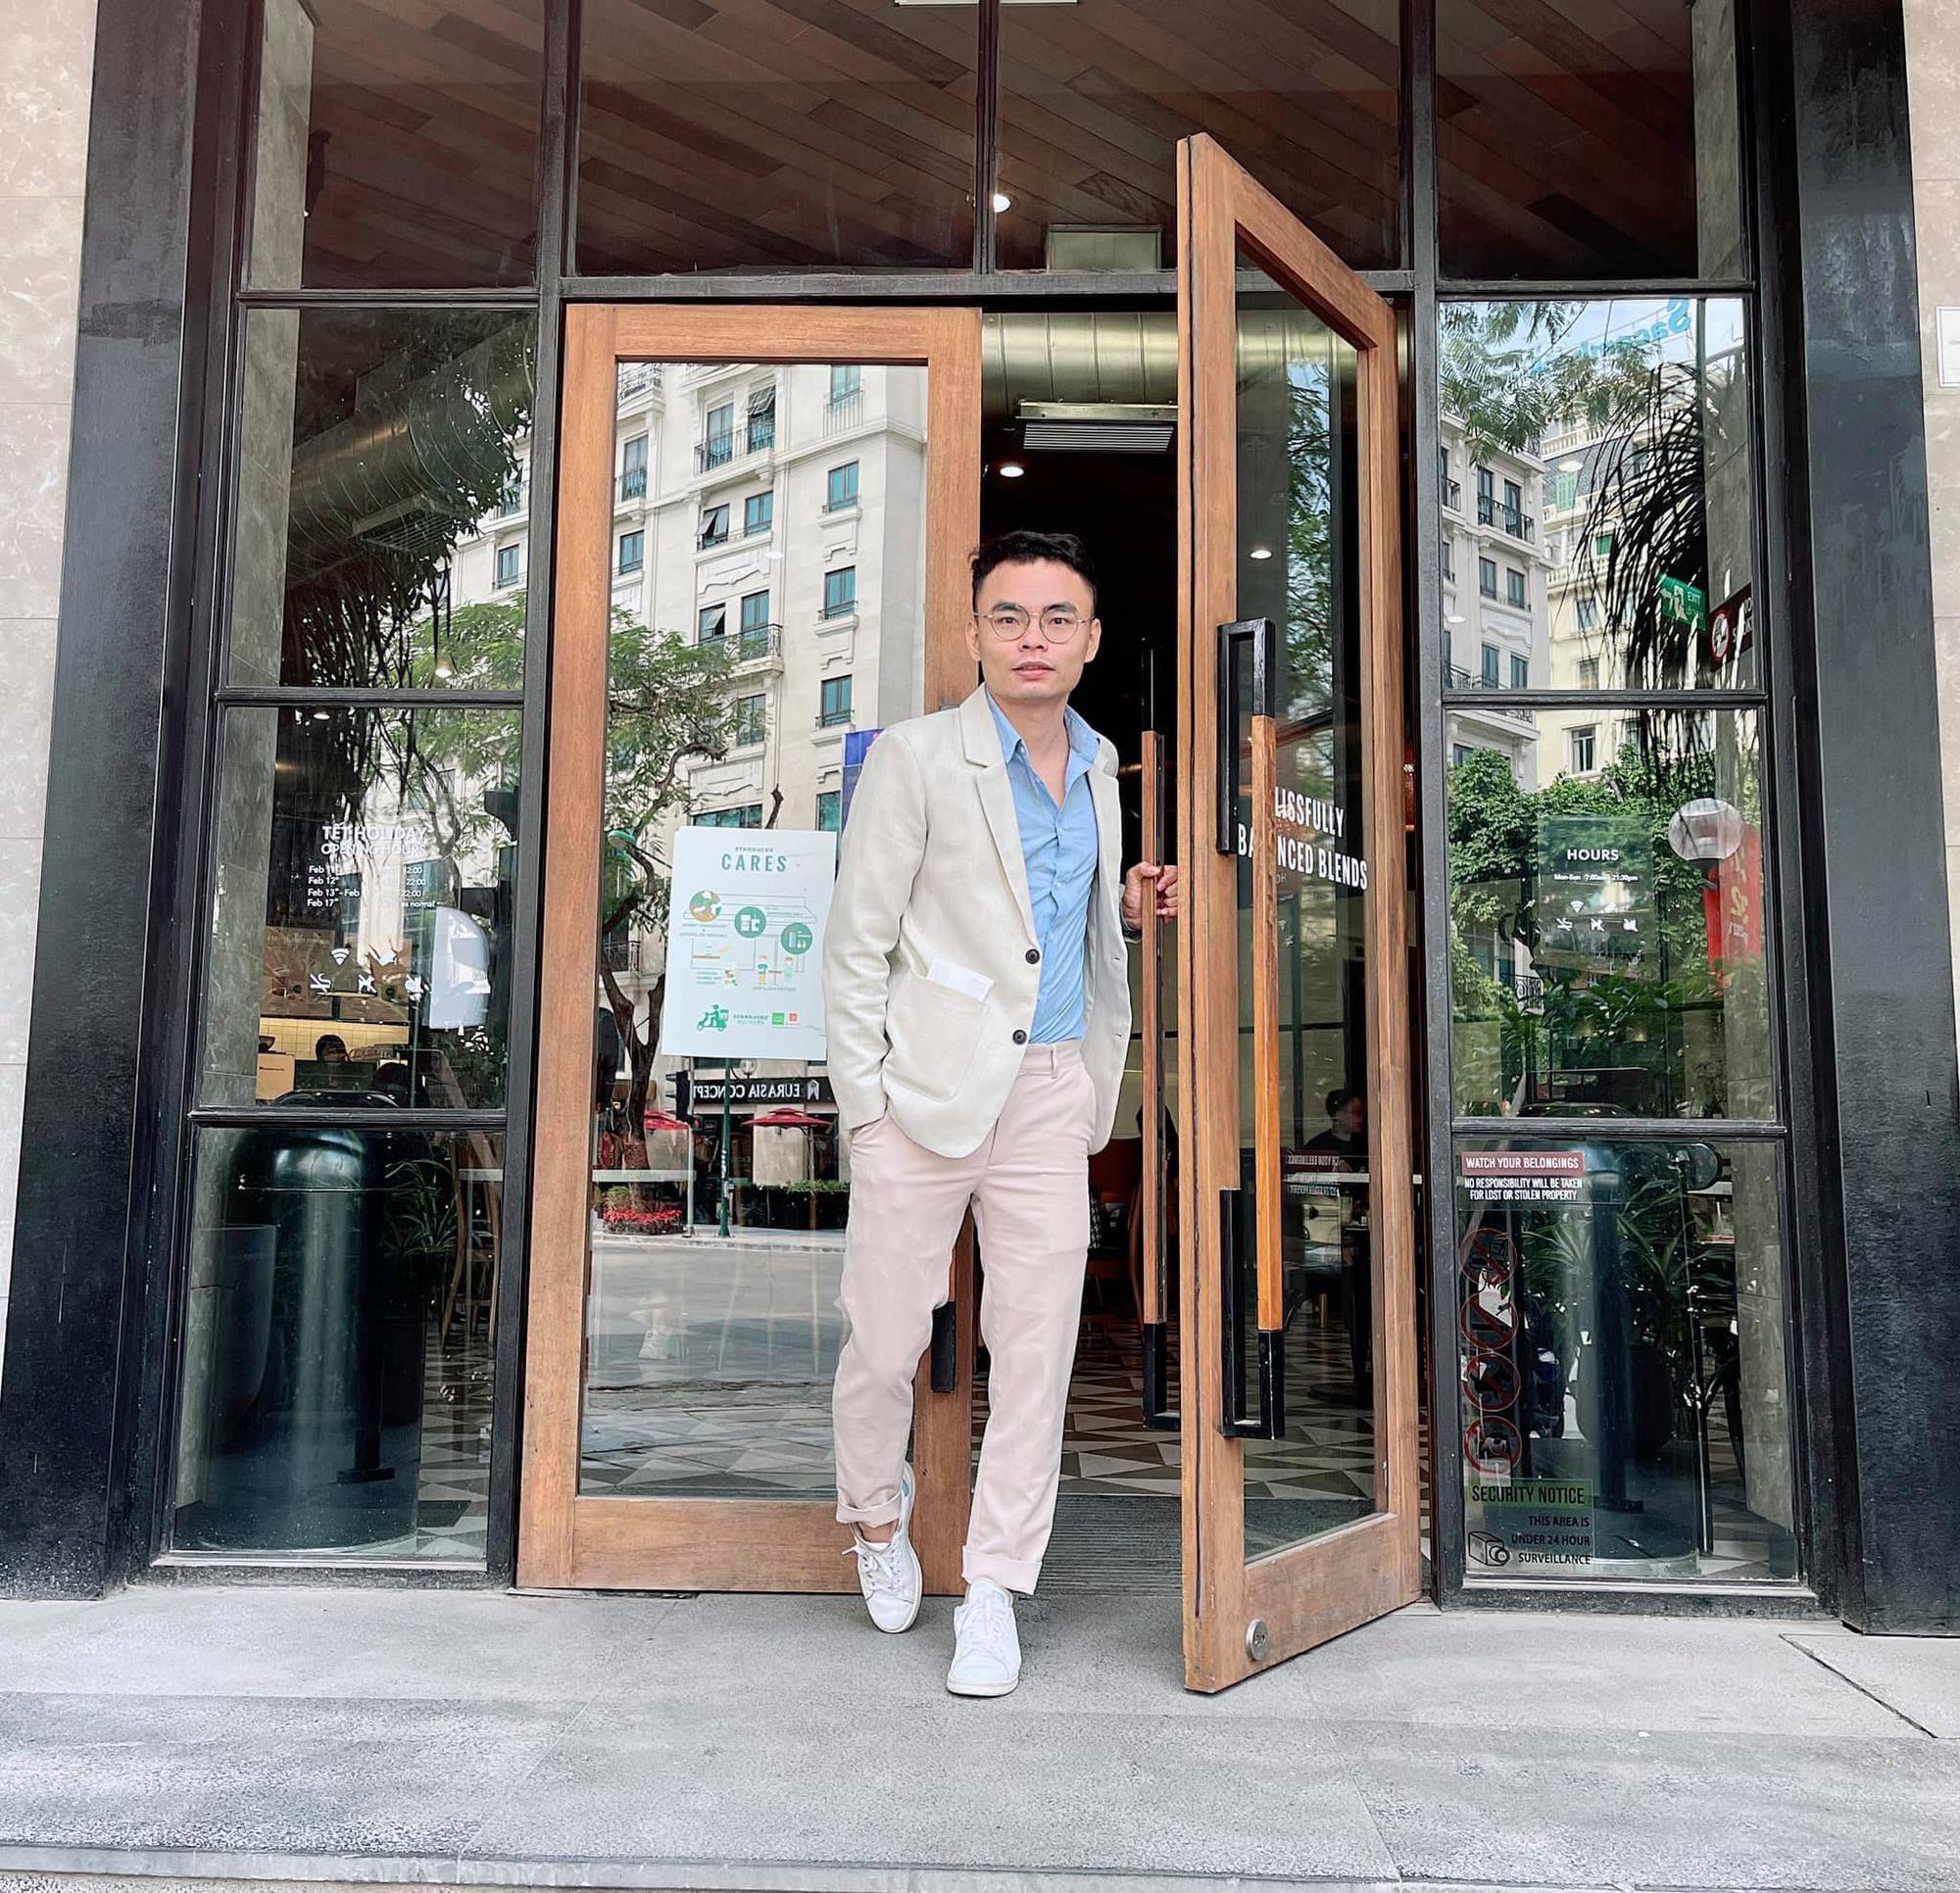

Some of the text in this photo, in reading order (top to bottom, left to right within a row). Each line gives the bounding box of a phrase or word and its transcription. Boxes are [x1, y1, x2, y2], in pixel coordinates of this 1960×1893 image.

[1275, 786, 1345, 838] LISSFULLY
[1567, 849, 1620, 861] HOURS
[721, 853, 787, 872] CARES
[309, 864, 324, 874] Feb
[1318, 848, 1369, 891] BLENDS
[308, 876, 324, 885] Feb
[307, 887, 323, 897] Feb
[344, 888, 361, 898] Feb
[306, 898, 323, 907] Feb
[1465, 1157, 1580, 1169] WATCH YOUR BELONGINGS
[1464, 1178, 1583, 1189] NO RESPONSIBILITY WILL BE TAKEN
[1470, 1189, 1578, 1200] FOR LOST OR STOLEN PROPERTY
[1472, 1485, 1586, 1504] SECURITY NOTICE
[1528, 1516, 1590, 1528] THIS AREA IS
[1511, 1534, 1591, 1546] UNDER 24 HOUR
[1518, 1553, 1592, 1565] SURVEILLANCE
